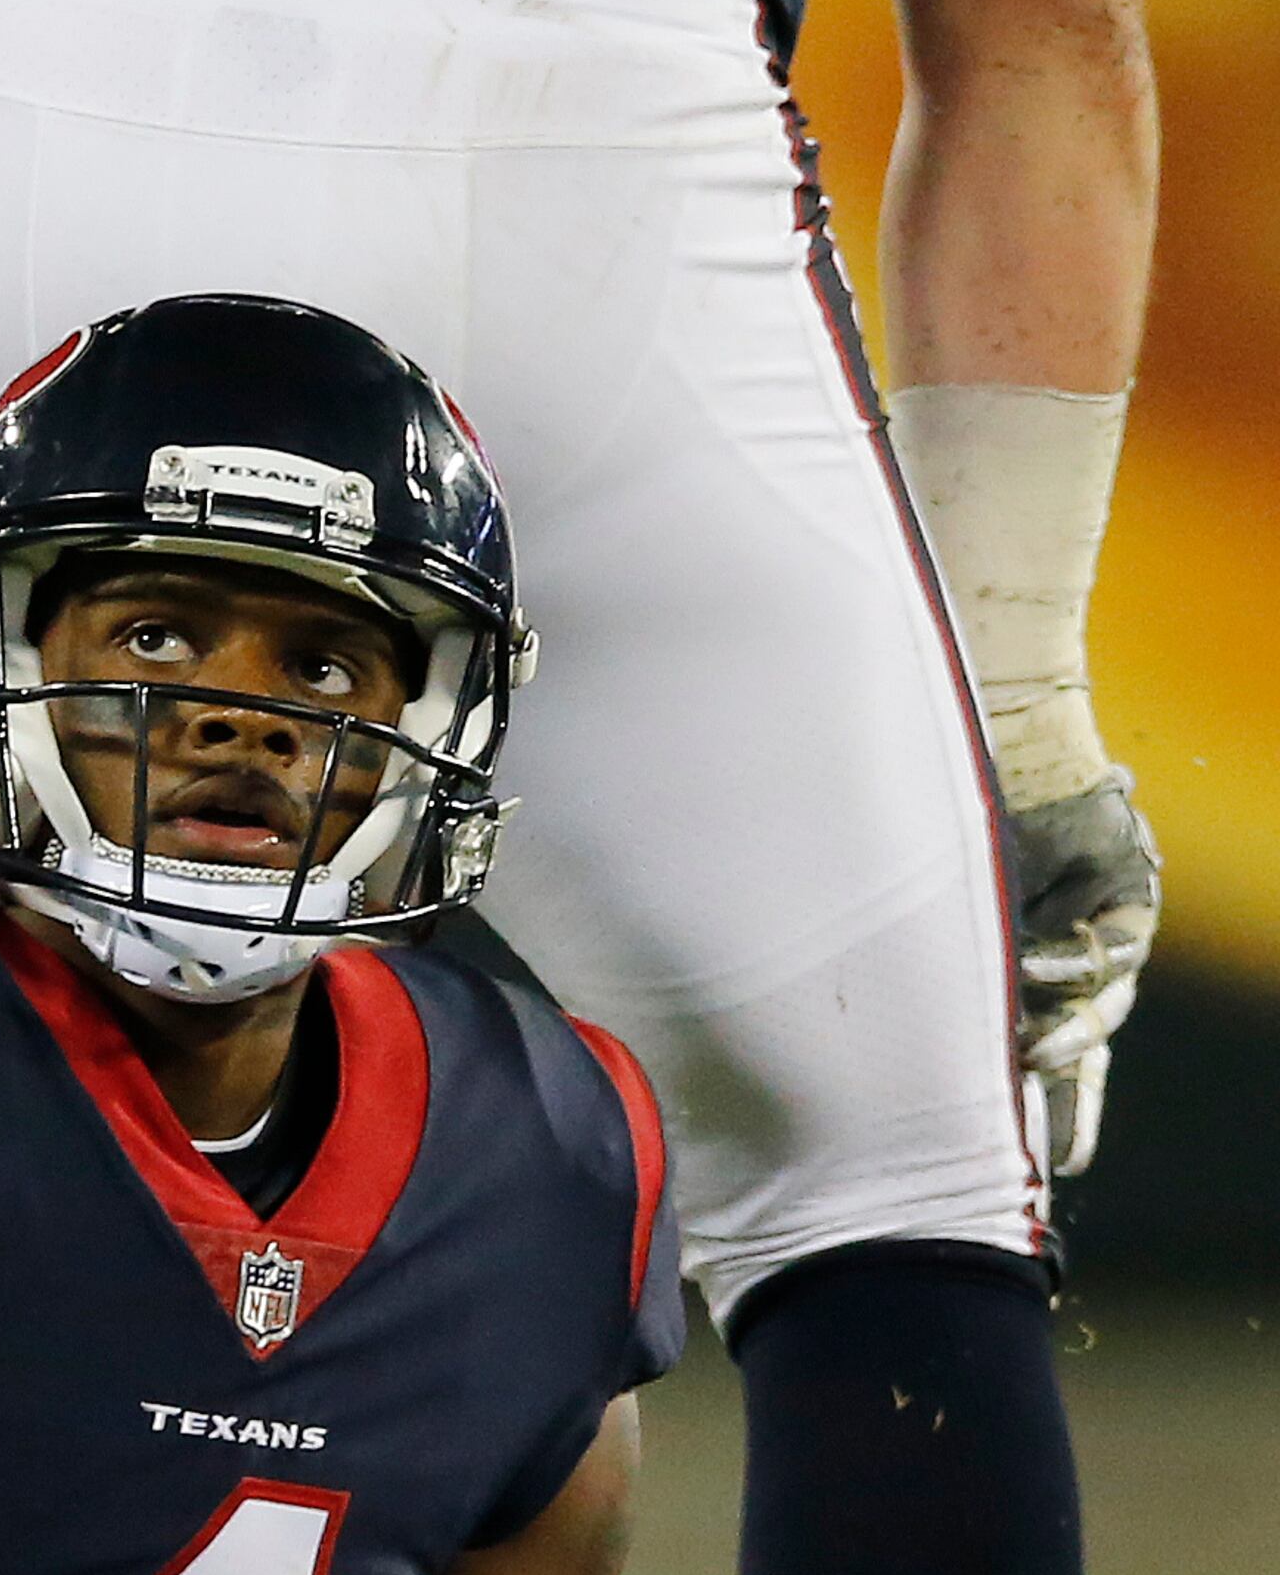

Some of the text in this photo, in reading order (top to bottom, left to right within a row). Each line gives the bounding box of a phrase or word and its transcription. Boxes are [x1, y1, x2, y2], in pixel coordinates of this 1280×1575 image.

[207, 464, 317, 487] TEXANS
[245, 1289, 289, 1327] NFL
[140, 1401, 328, 1450] TEXANS
